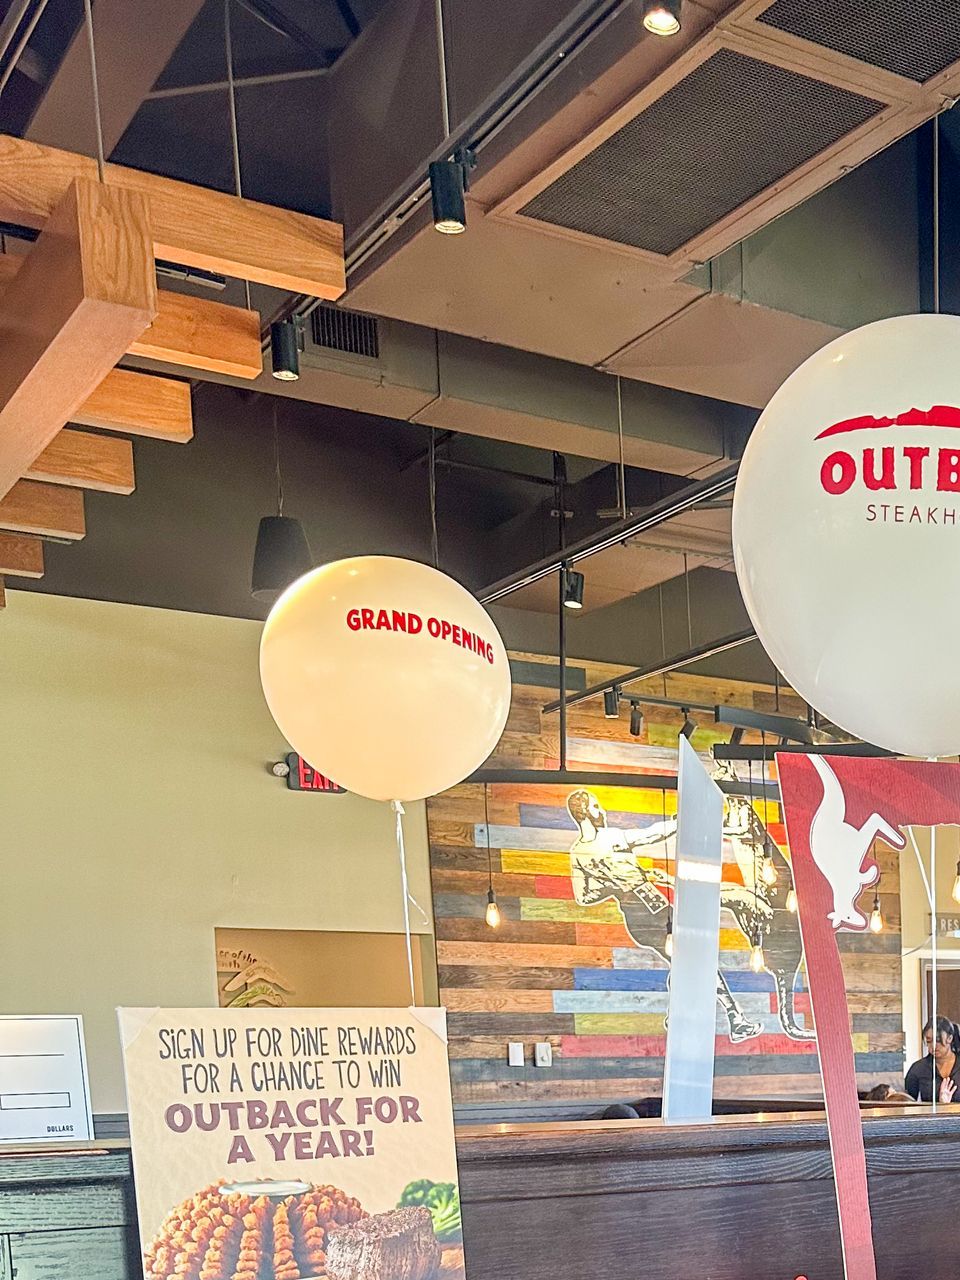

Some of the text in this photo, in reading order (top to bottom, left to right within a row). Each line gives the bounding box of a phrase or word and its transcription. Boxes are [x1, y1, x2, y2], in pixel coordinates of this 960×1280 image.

[347, 608, 494, 664] GRAND OPENING
[213, 1028, 237, 1058] UP
[245, 1027, 282, 1057] FOR
[337, 1026, 417, 1056] REWARDS
[181, 1063, 220, 1094] FOR
[230, 1062, 243, 1092] A
[251, 1061, 325, 1092] CHANCE
[332, 1060, 360, 1088] TO
[47, 1125, 74, 1133] DOLLARS
[164, 1095, 423, 1133] OUTBACK FOR
[227, 1130, 375, 1164] A YEAR!
